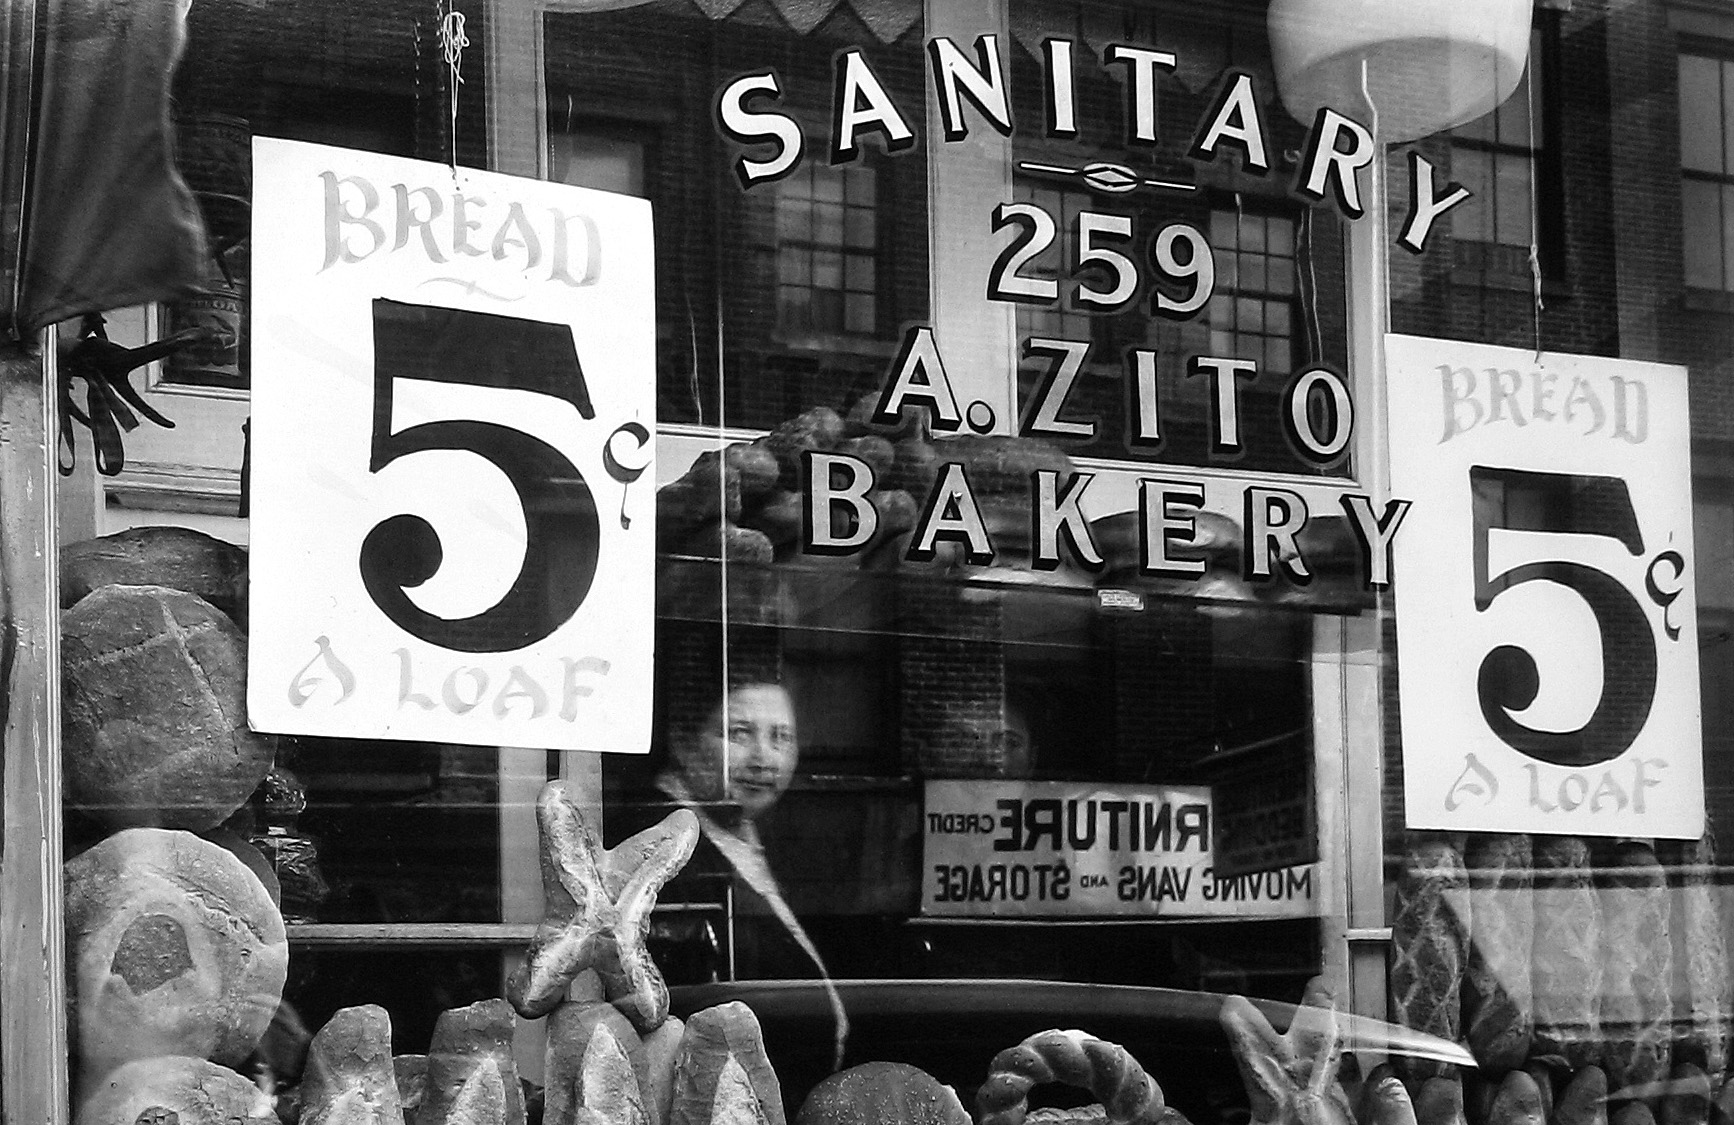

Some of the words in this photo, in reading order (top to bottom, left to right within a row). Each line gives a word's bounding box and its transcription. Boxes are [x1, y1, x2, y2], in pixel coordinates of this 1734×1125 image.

[718, 34, 1470, 253] SANITARY
[316, 170, 601, 288] BREAD
[987, 202, 1214, 319] 259
[874, 328, 996, 434] A.
[1021, 336, 1355, 463] ZITO
[1435, 364, 1650, 444] BREAD
[802, 450, 1412, 591] BAKERY
[288, 636, 355, 707] A
[391, 647, 611, 723] LOAF
[1444, 753, 1500, 812] A
[1523, 757, 1669, 814] LOAF
